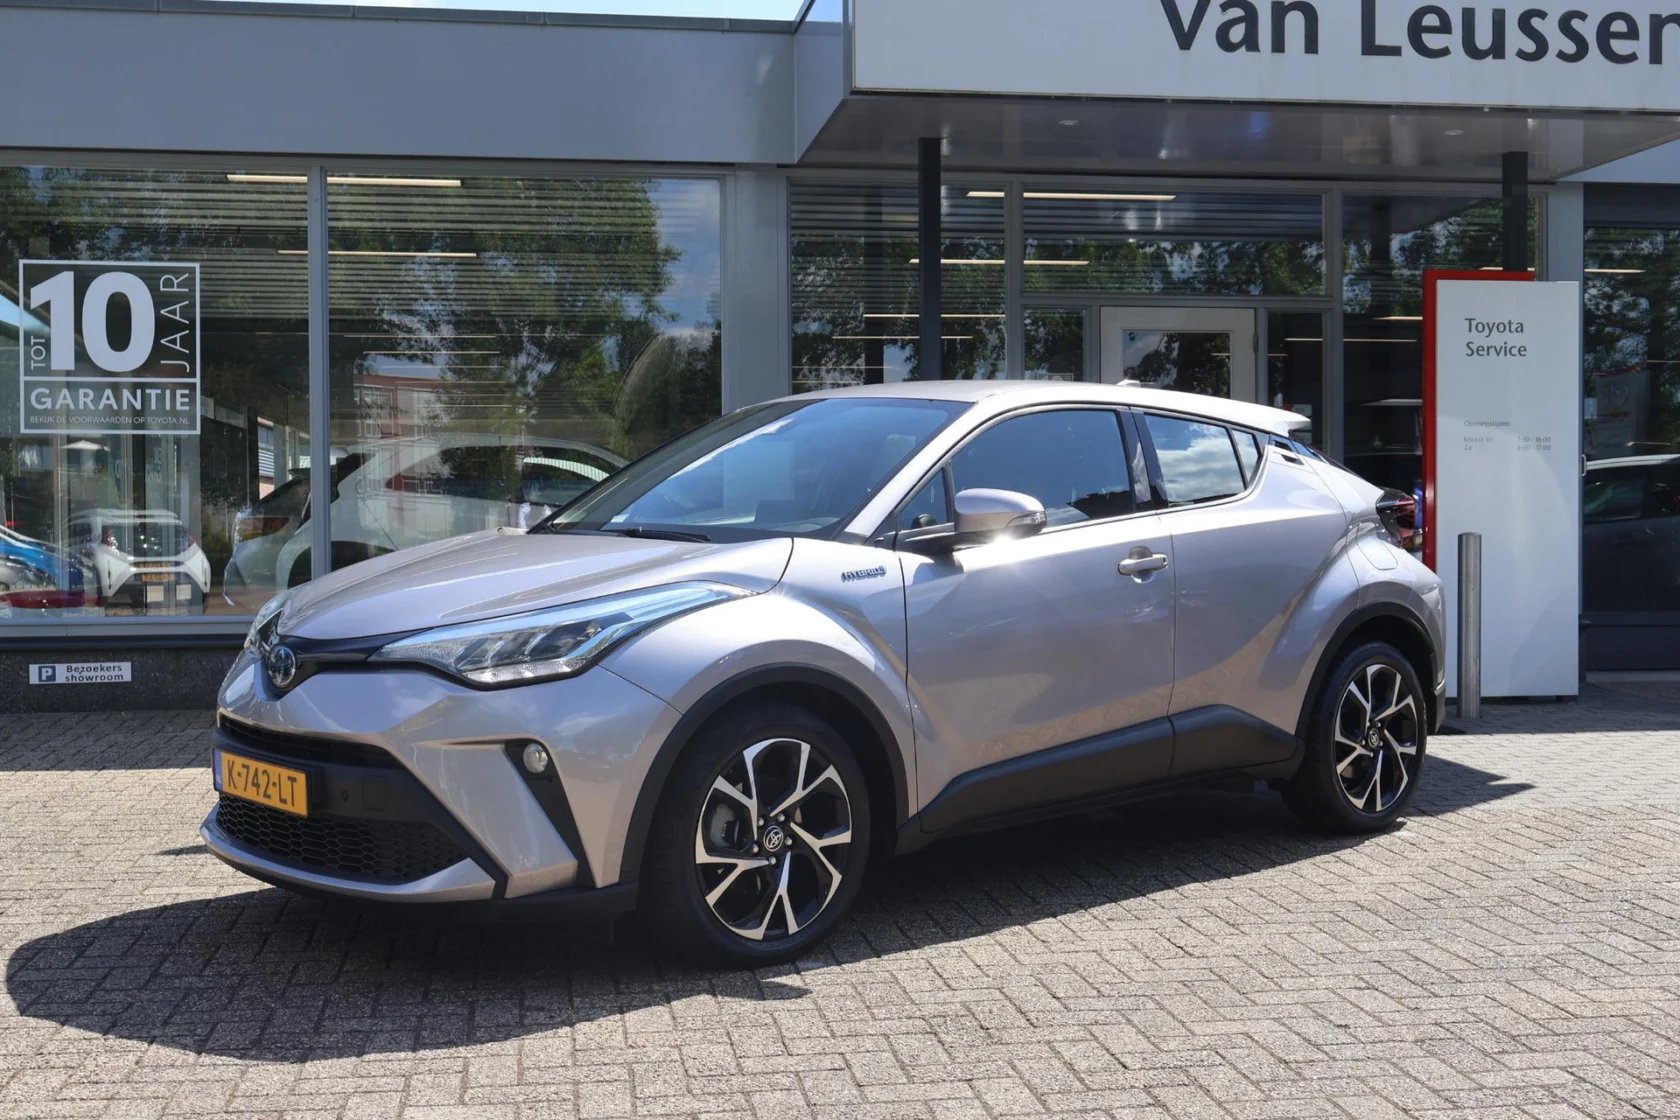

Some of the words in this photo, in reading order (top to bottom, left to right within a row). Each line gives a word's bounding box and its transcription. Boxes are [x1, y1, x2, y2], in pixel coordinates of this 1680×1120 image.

[1161, 0, 1319, 54] Van
[30, 271, 155, 373] 10
[160, 273, 190, 373] JAAR
[1464, 317, 1525, 338] Toyota
[31, 335, 46, 370] TOT
[1465, 341, 1528, 357] Service
[30, 387, 190, 411] GARANTIE
[56, 415, 67, 425] DE
[69, 415, 132, 425] VOORWAARDEN
[134, 415, 145, 425] OP
[147, 415, 190, 425] TOYOTA.NL
[65, 674, 124, 682] showroom
[66, 664, 122, 673] Bezoekers
[227, 759, 298, 807] K-742-LT
